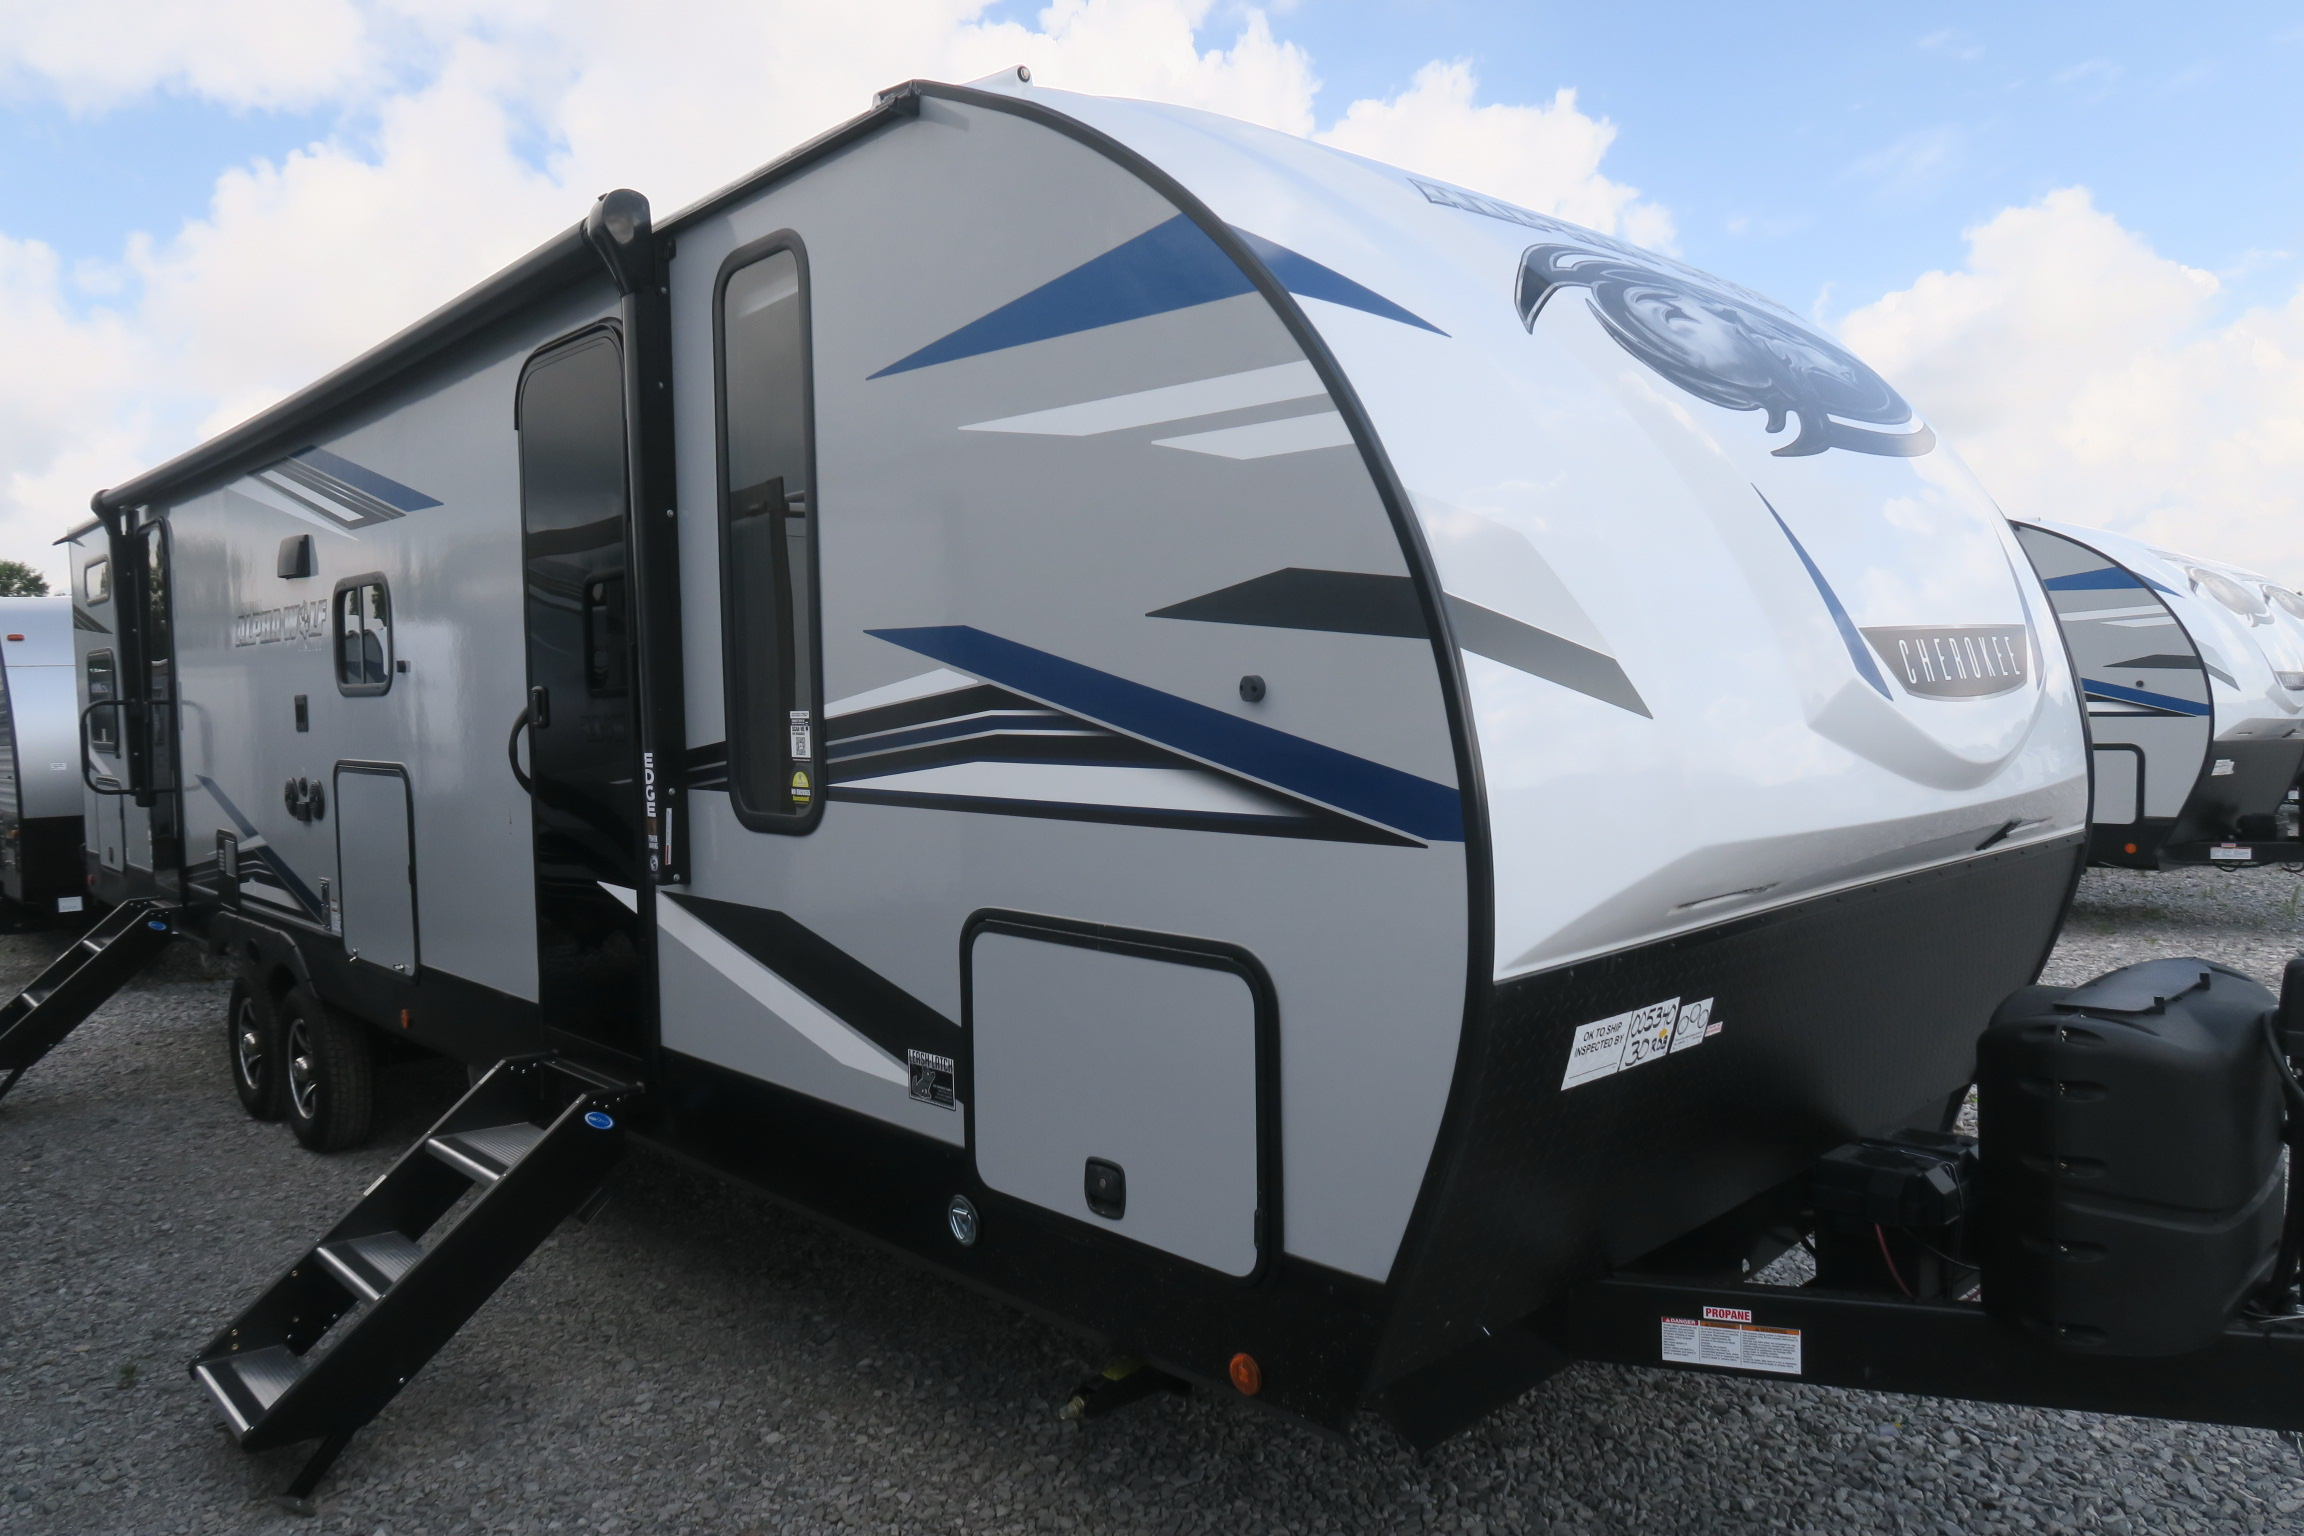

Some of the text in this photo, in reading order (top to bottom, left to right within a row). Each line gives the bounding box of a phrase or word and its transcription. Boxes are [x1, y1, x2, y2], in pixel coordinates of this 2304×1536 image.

[235, 608, 280, 647] ALPHA
[1898, 636, 2021, 684] CHEROKEE
[644, 752, 657, 818] EDGE
[1583, 1021, 1623, 1042] OK TO SHIP
[1574, 1033, 1625, 1058] INSPECTED BY
[1670, 1317, 1696, 1325] DANGER
[1705, 1307, 1751, 1321] PROPANE
